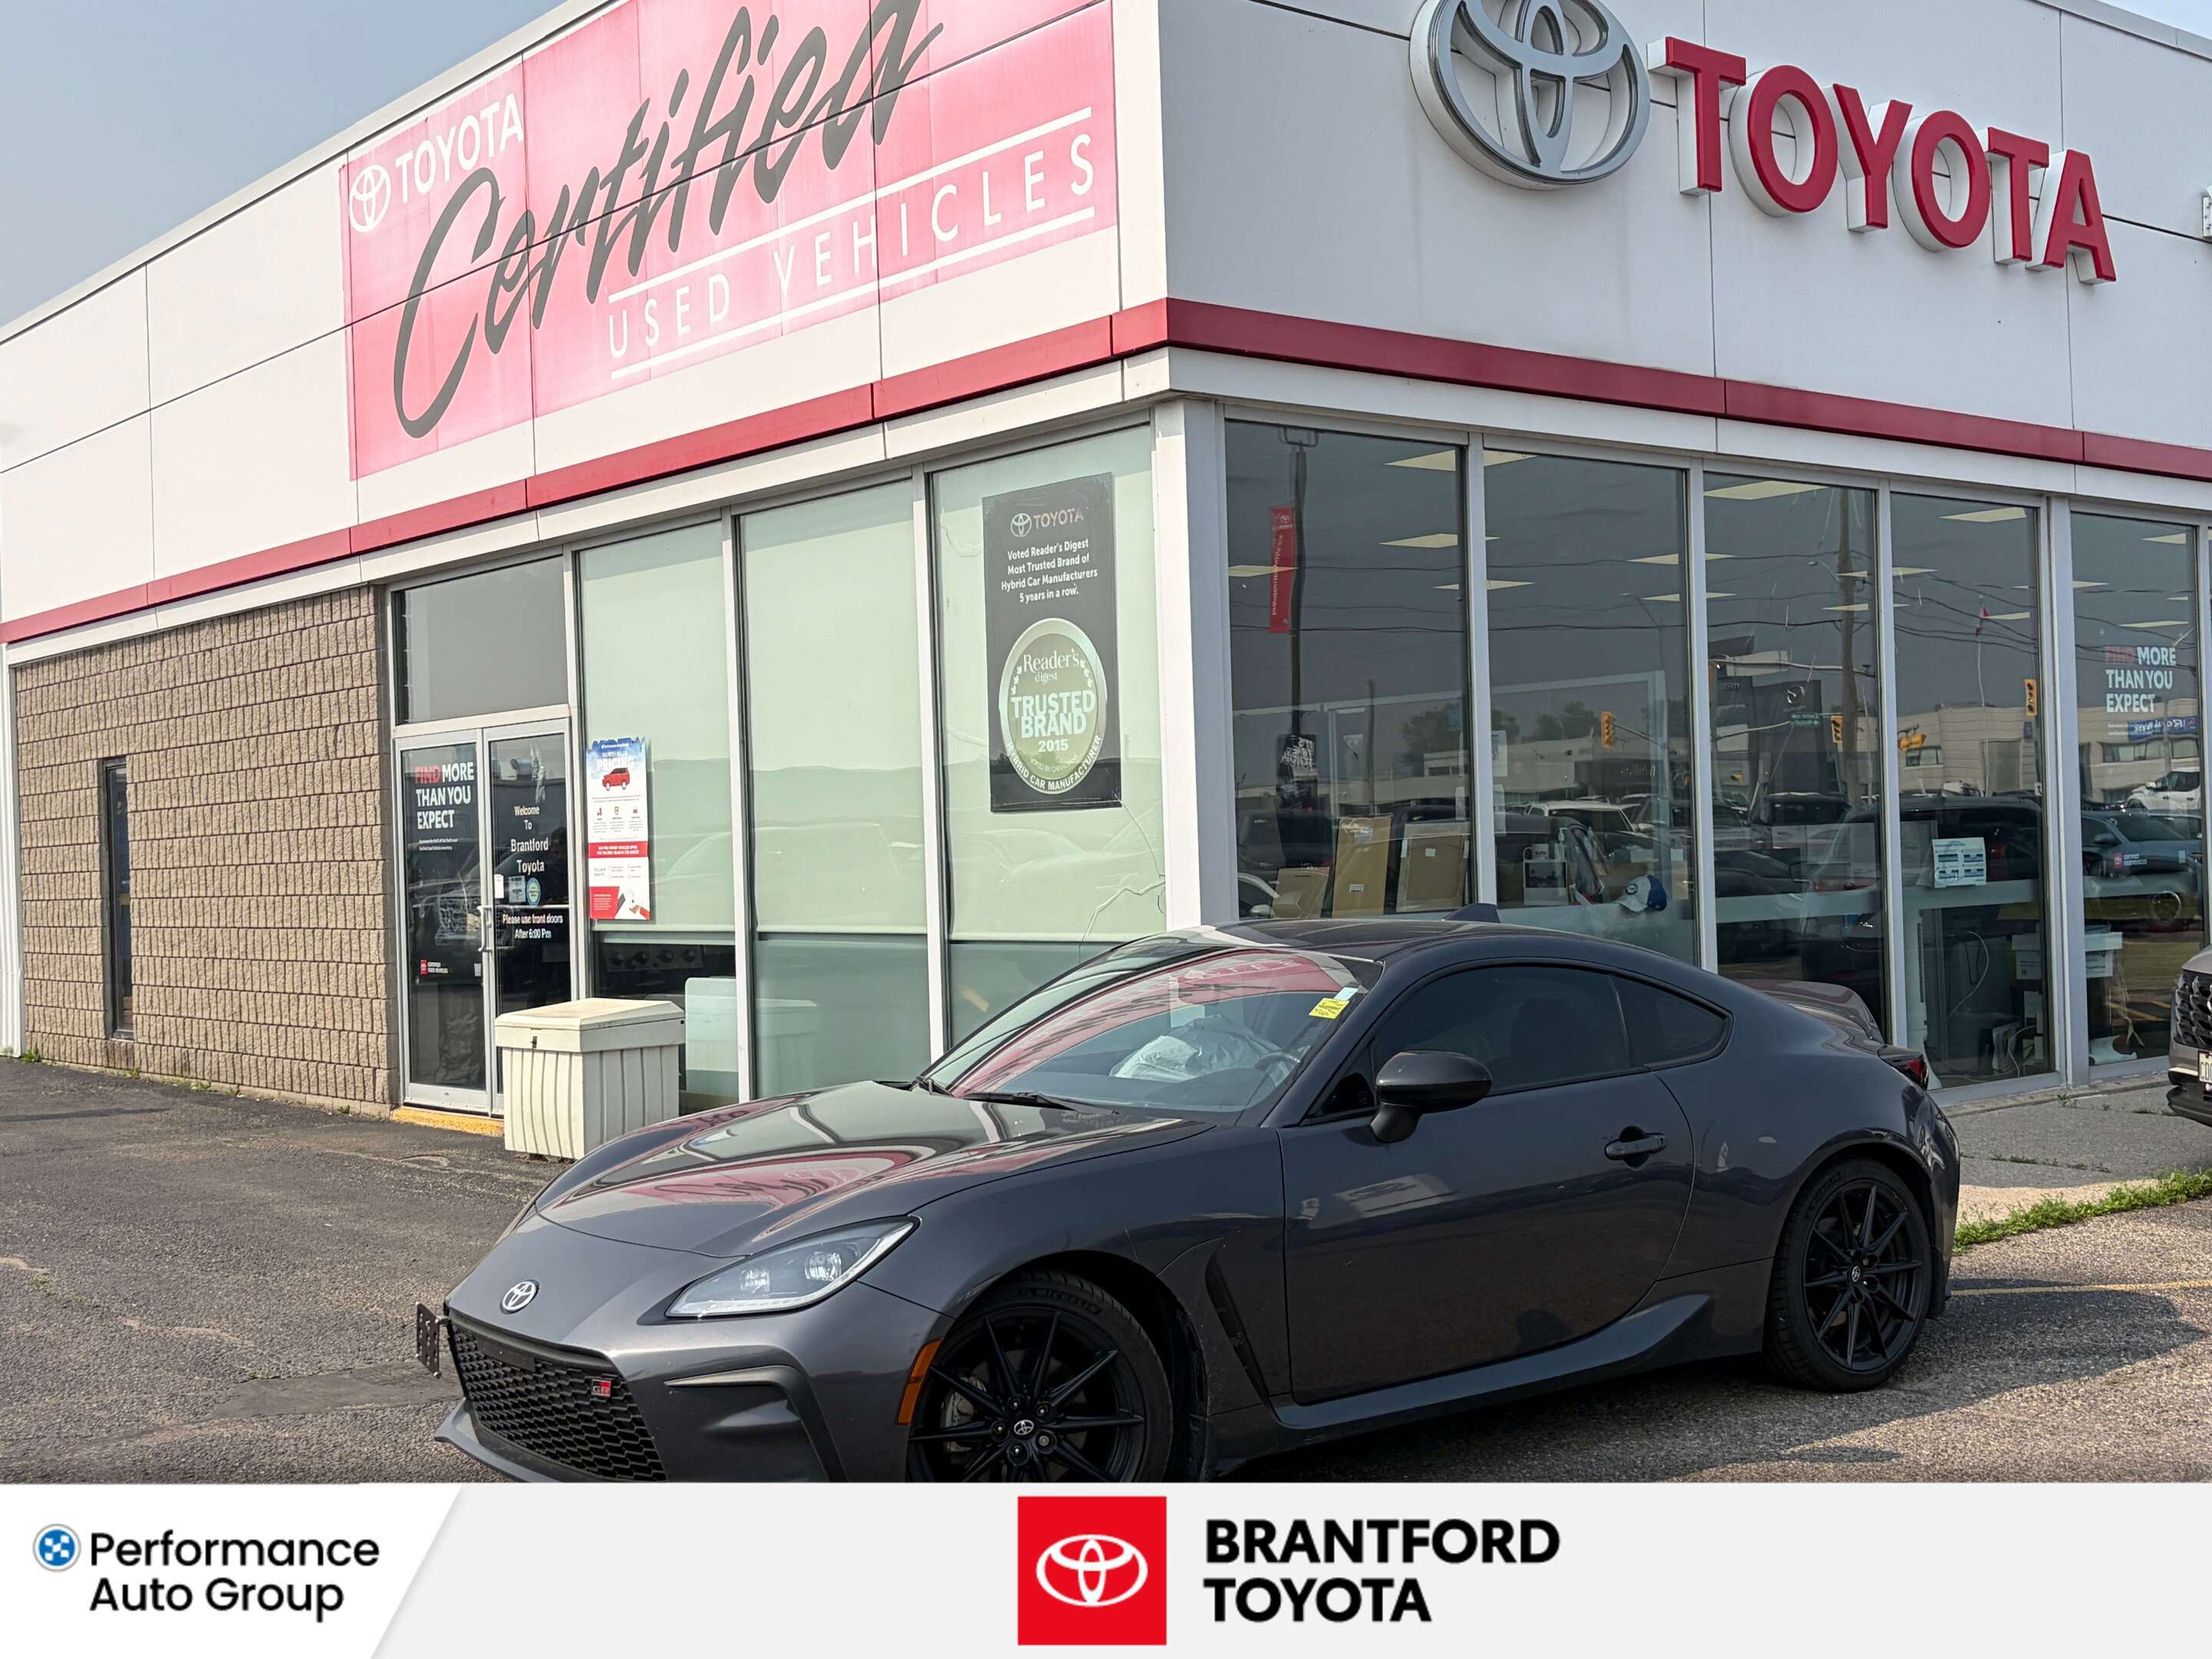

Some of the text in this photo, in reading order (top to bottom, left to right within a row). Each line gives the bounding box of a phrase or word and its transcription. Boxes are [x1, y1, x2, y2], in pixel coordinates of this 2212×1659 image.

[396, 92, 524, 204] TOYOTA
[1651, 36, 2117, 284] TOYOTA
[393, 0, 943, 439] Certified
[608, 133, 1095, 359] USED VEHICLES
[1033, 508, 1084, 528] TOYOTA
[1008, 538, 1088, 561] Voted Reader's Digest
[1008, 553, 1089, 575] Most Trusted Brand of
[1002, 569, 1098, 592] Hybrid Car Manufacturers
[1019, 593, 1025, 602] 5
[1025, 591, 1045, 604] years
[1047, 589, 1054, 599] in
[1023, 648, 1080, 673] Reader's
[2137, 647, 2177, 666] MORE
[1035, 671, 1058, 684] digest
[2106, 669, 2173, 690] THAN YOU
[1011, 690, 1095, 718] TRUSTED
[2106, 694, 2155, 713] EXPECT
[1021, 713, 1087, 738] BRAND
[1038, 740, 1068, 753] 2015
[416, 762, 475, 783] FIND MORE
[1005, 735, 1101, 790] HYBRID CAR MANUFACTURER
[416, 786, 471, 806] THAN YOU
[417, 810, 455, 830] EXPECT
[514, 806, 540, 816] Welcome
[524, 820, 532, 830] To
[511, 837, 548, 852] Brantford
[516, 859, 545, 876] Toyota
[502, 913, 564, 924] Please use front doors
[515, 929, 528, 939] After
[529, 929, 541, 939] 6:00
